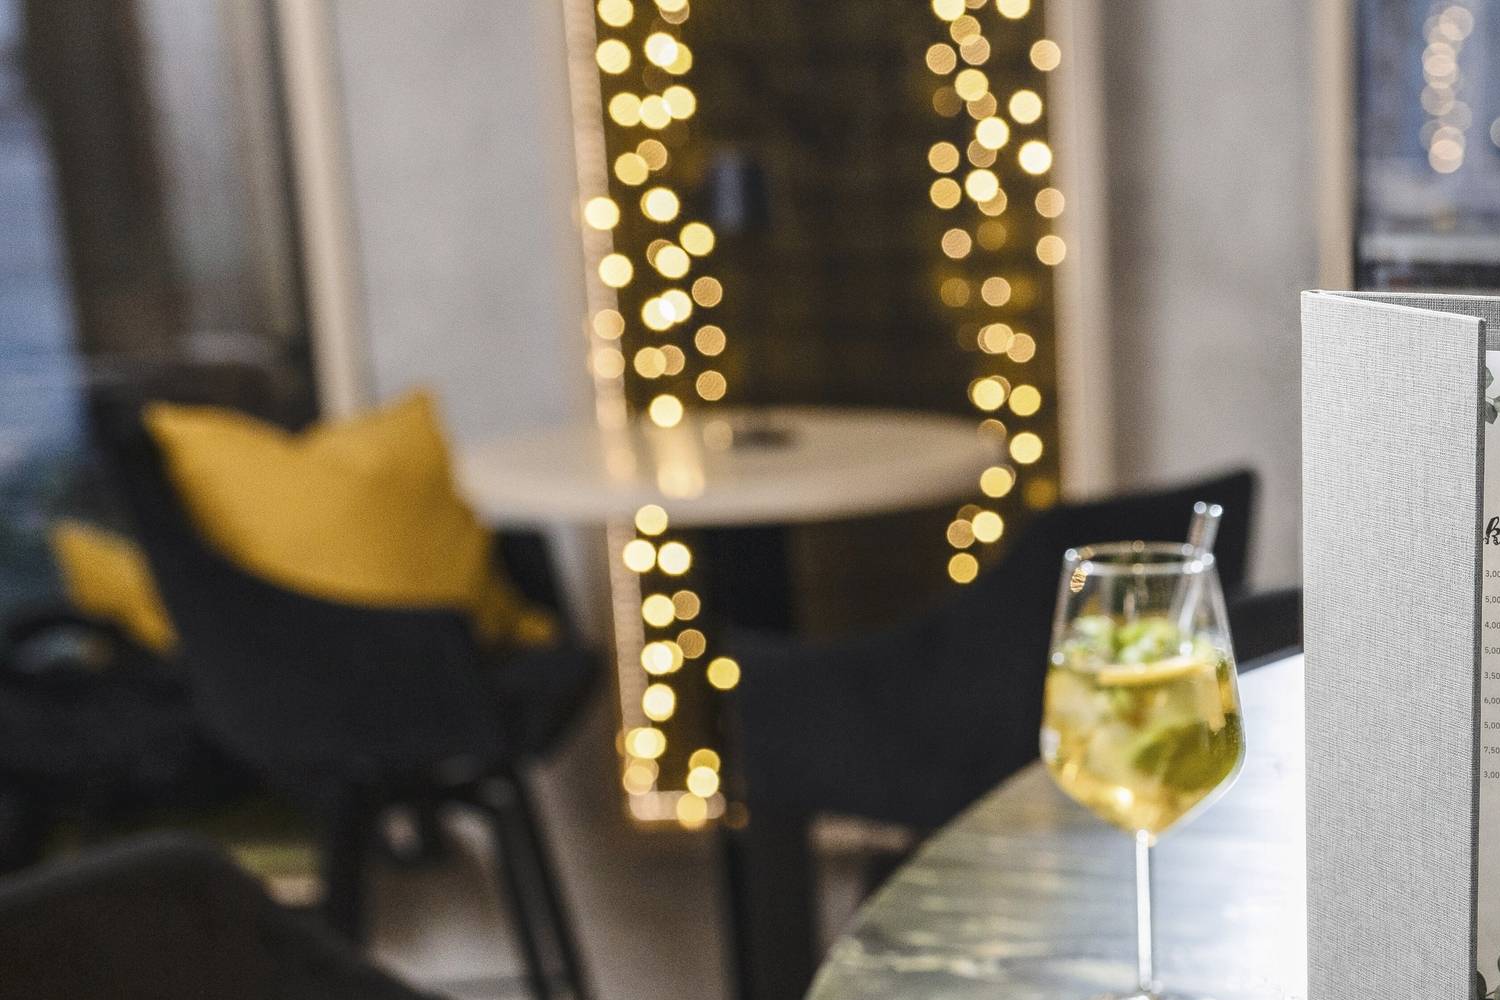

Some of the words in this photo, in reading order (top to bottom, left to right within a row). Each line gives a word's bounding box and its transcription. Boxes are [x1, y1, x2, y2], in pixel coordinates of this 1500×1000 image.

[1483, 671, 1500, 681] 3,50
[1483, 696, 1500, 705] 6,00
[1483, 721, 1500, 730] 5,00
[1483, 745, 1500, 755] 7,50
[1483, 770, 1500, 779] 3,00
